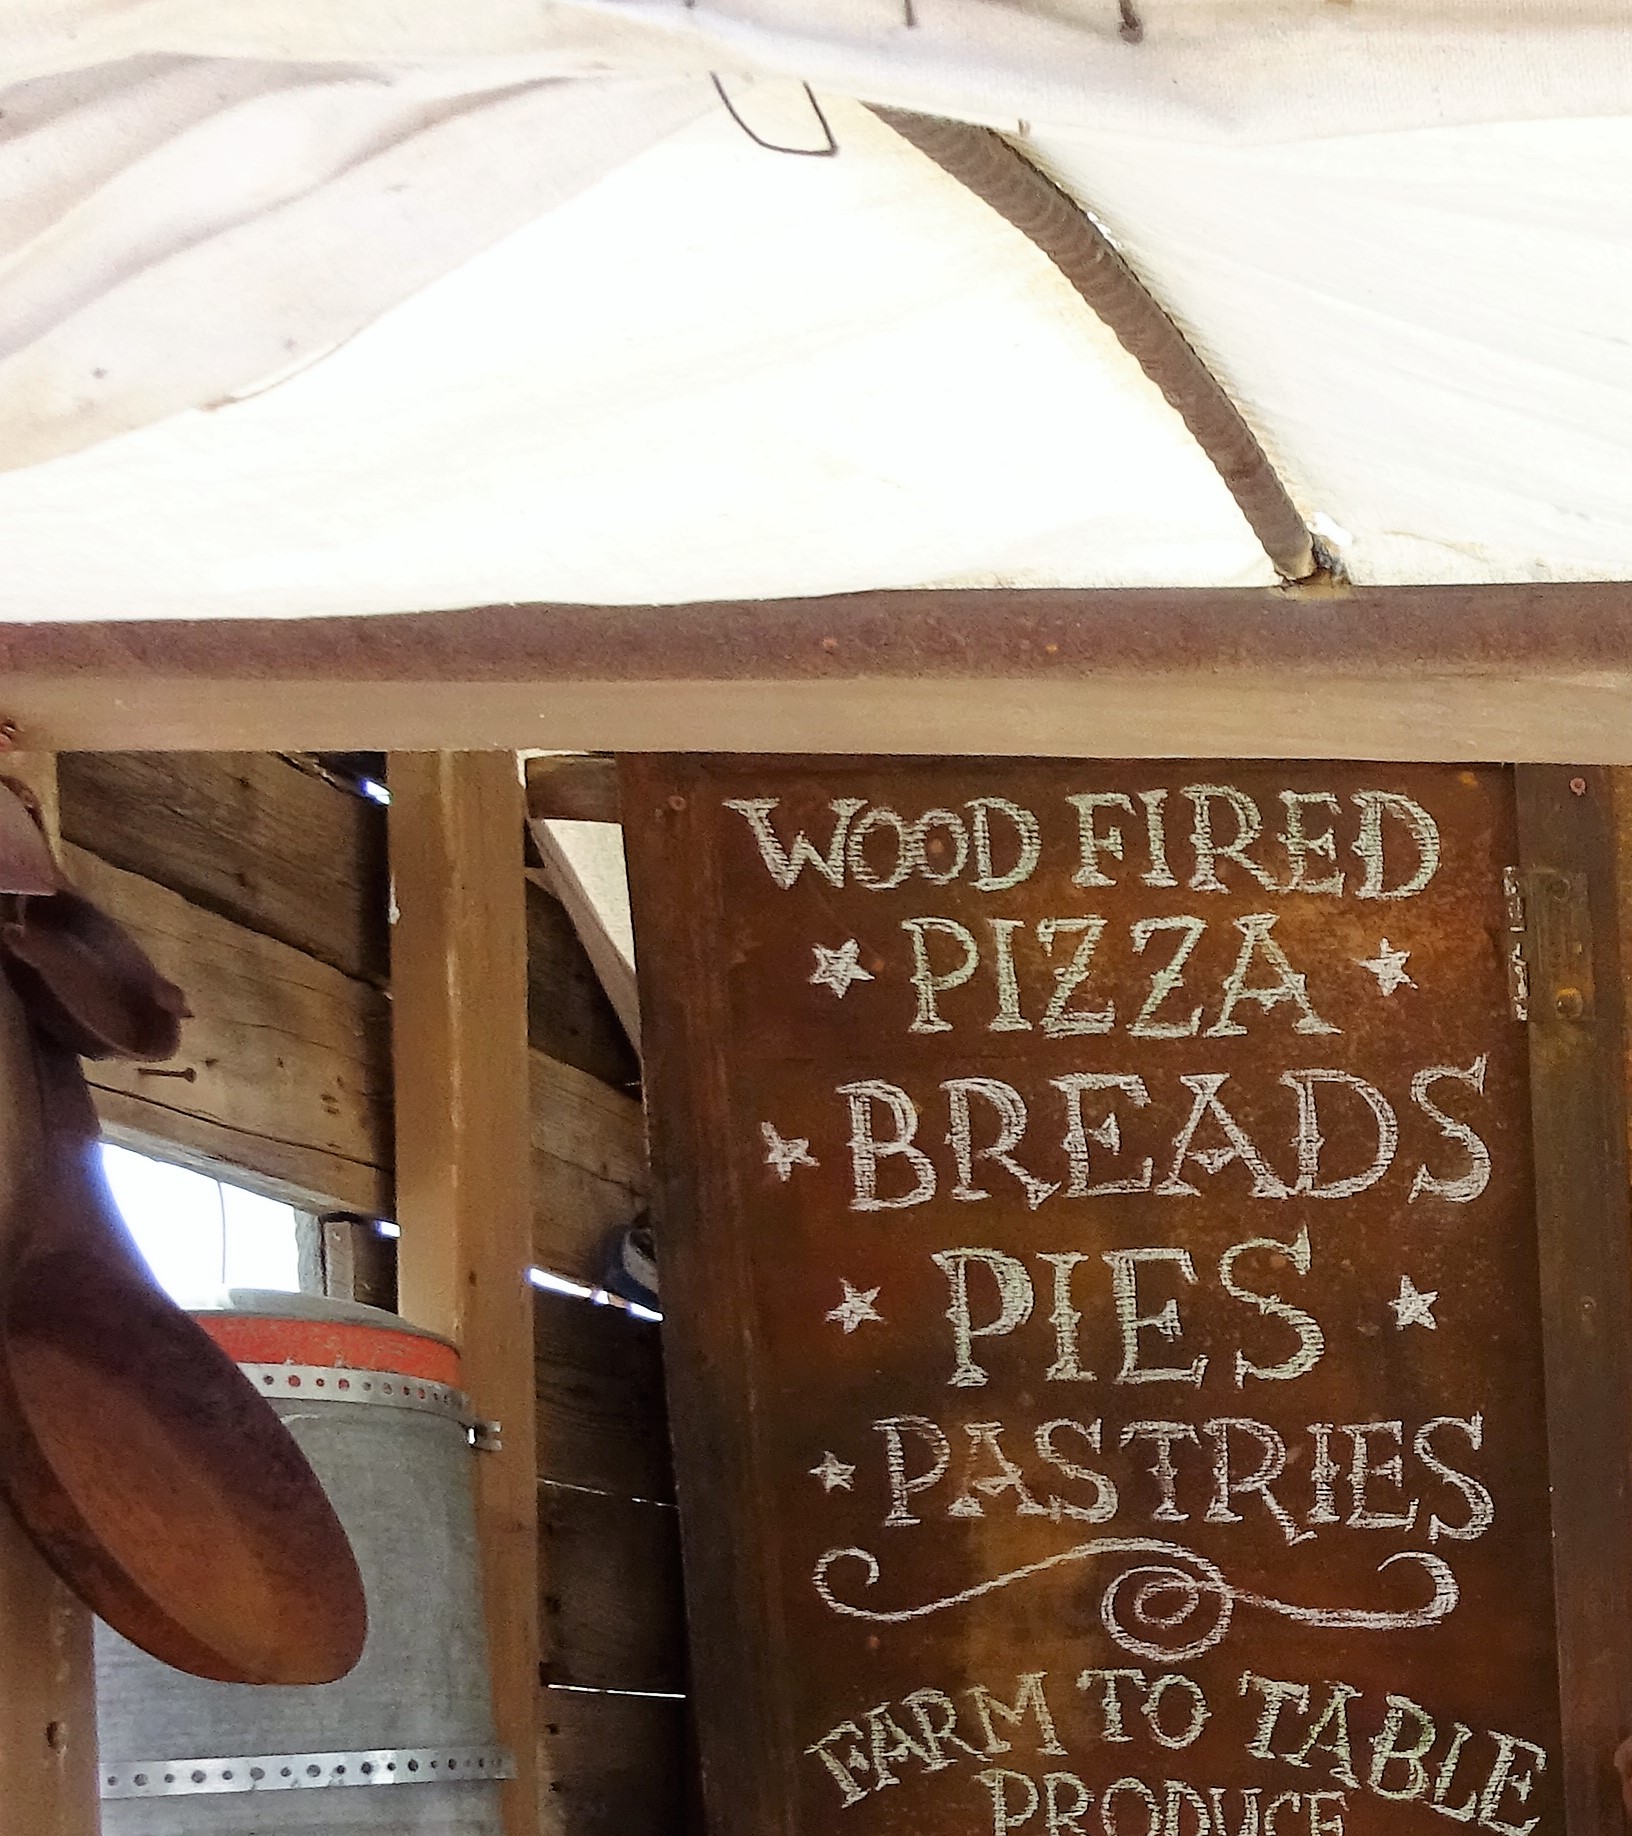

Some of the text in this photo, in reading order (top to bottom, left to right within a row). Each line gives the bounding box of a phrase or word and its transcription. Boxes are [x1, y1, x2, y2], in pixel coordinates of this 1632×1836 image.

[723, 783, 1440, 899] WOOD FIRED
[902, 913, 1342, 1038] PIZZA
[836, 1053, 1491, 1210] BREADS
[932, 1223, 1326, 1387] PIES
[872, 1411, 1495, 1544] PASTRIES
[804, 1670, 1068, 1809] FARM
[1076, 1668, 1211, 1750] TO
